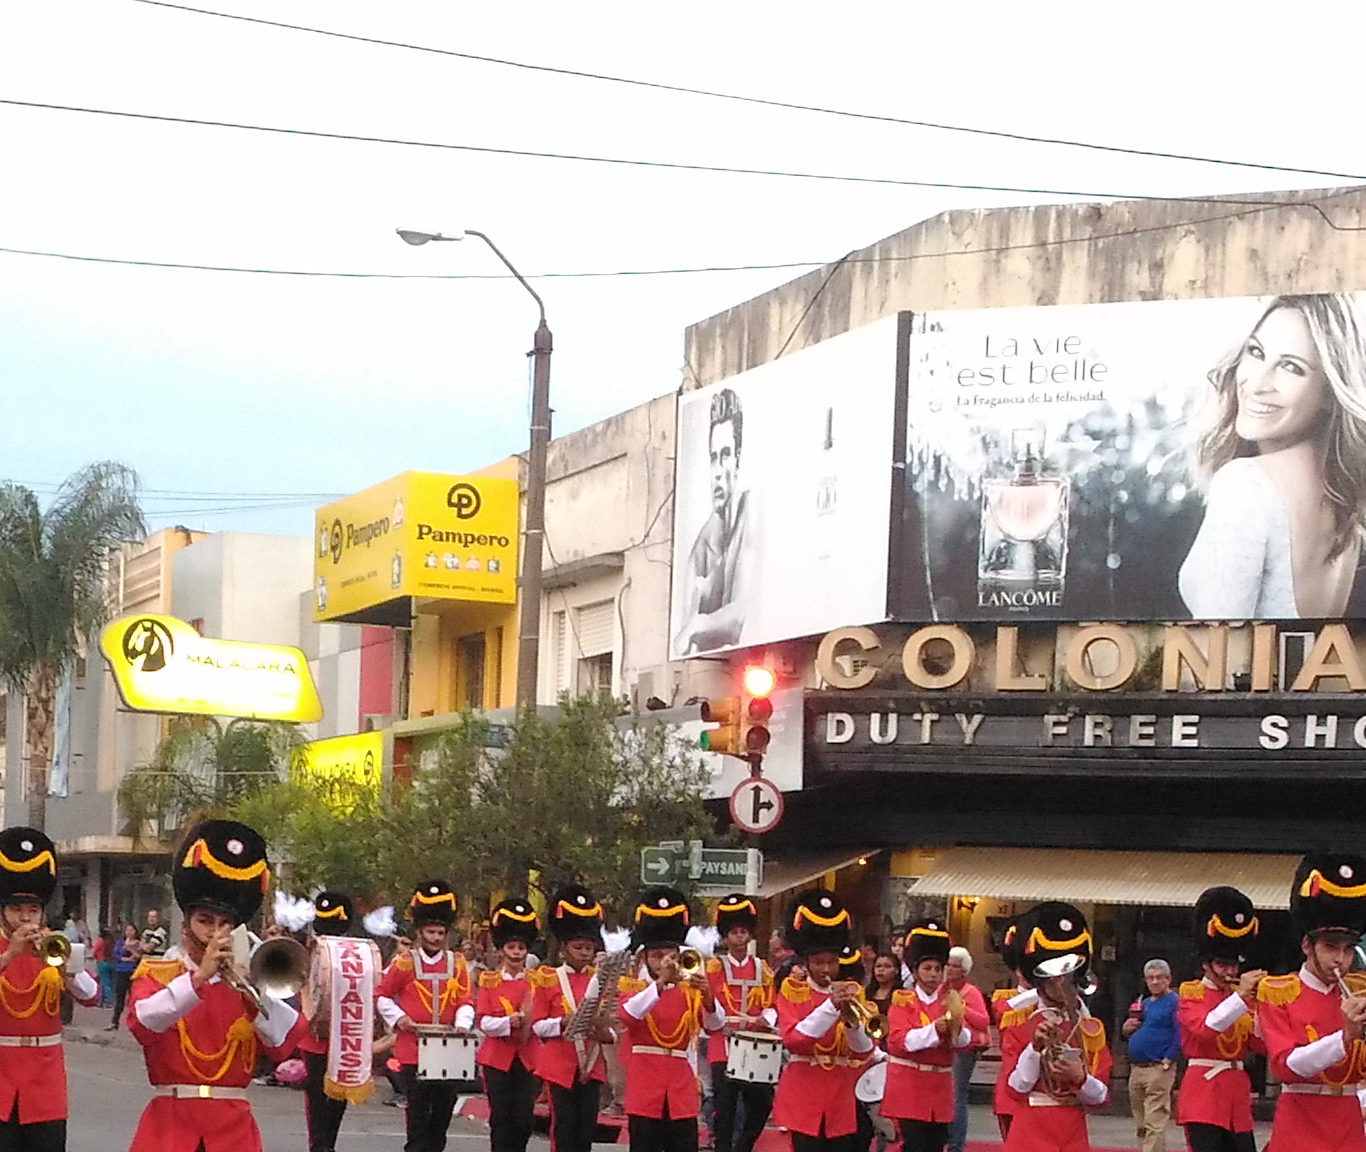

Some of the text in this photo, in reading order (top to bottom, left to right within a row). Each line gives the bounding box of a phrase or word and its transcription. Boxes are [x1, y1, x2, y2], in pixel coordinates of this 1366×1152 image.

[985, 334, 1081, 358] La vie
[957, 358, 1108, 387] est belle
[416, 523, 510, 548] Pampero
[826, 712, 985, 745] DUTY
[1043, 713, 1200, 747] FREE
